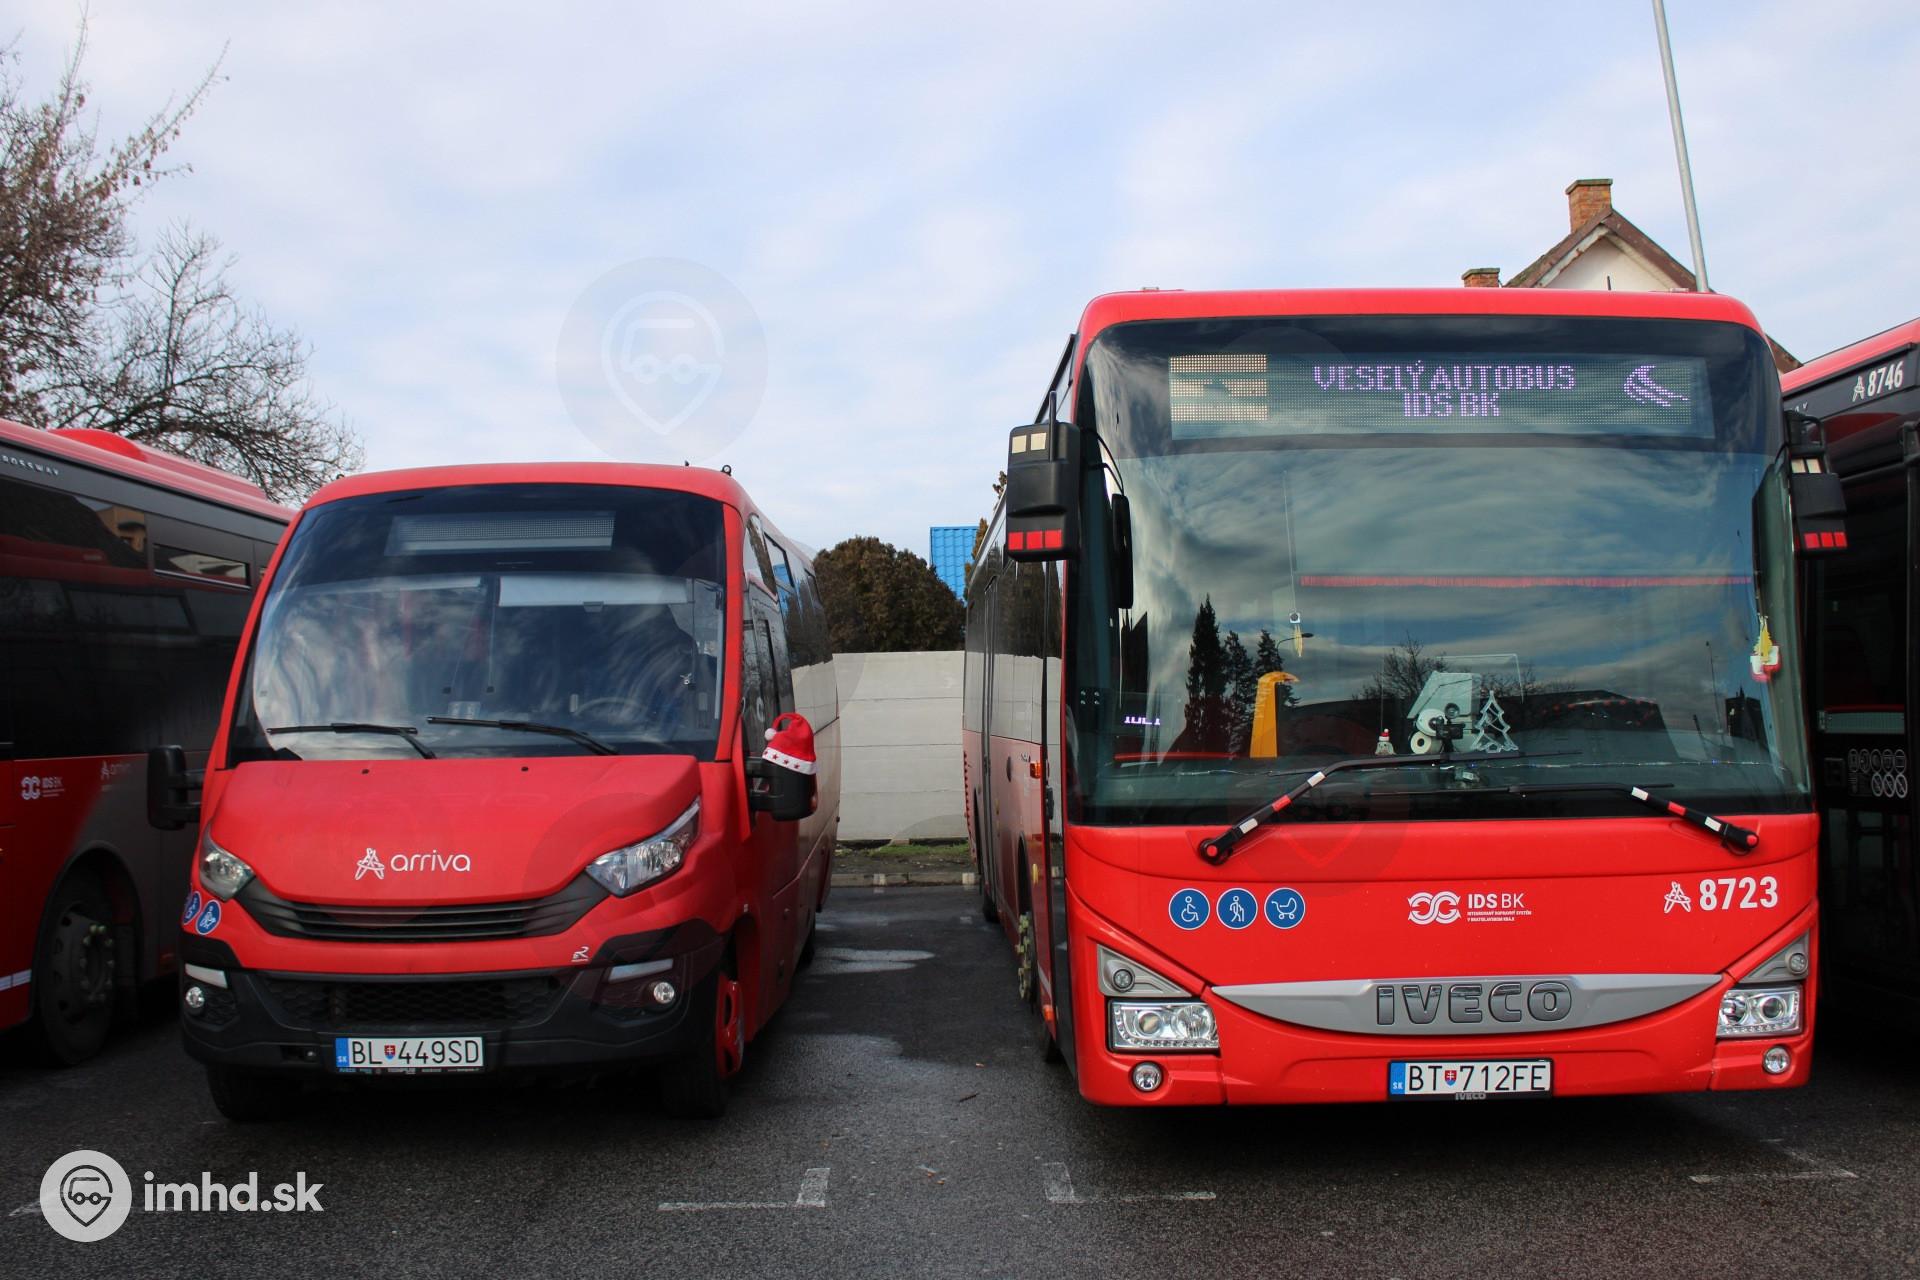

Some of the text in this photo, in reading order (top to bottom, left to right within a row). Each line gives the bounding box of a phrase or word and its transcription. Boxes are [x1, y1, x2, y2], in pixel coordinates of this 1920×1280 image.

[1313, 360, 1576, 391] VESELÝ AUTOBUS
[1867, 360, 1904, 397] 8746
[1403, 392, 1501, 417] IDS BK
[390, 849, 471, 872] arriva
[1468, 893, 1525, 909] IDS BK
[1699, 876, 1778, 911] 8723
[1377, 980, 1572, 1025] IVECO
[351, 1041, 382, 1065] BL
[398, 1040, 479, 1065] 449SD
[1392, 1065, 1547, 1091] SK BT 712FE
[1455, 1091, 1487, 1101] IVECO
